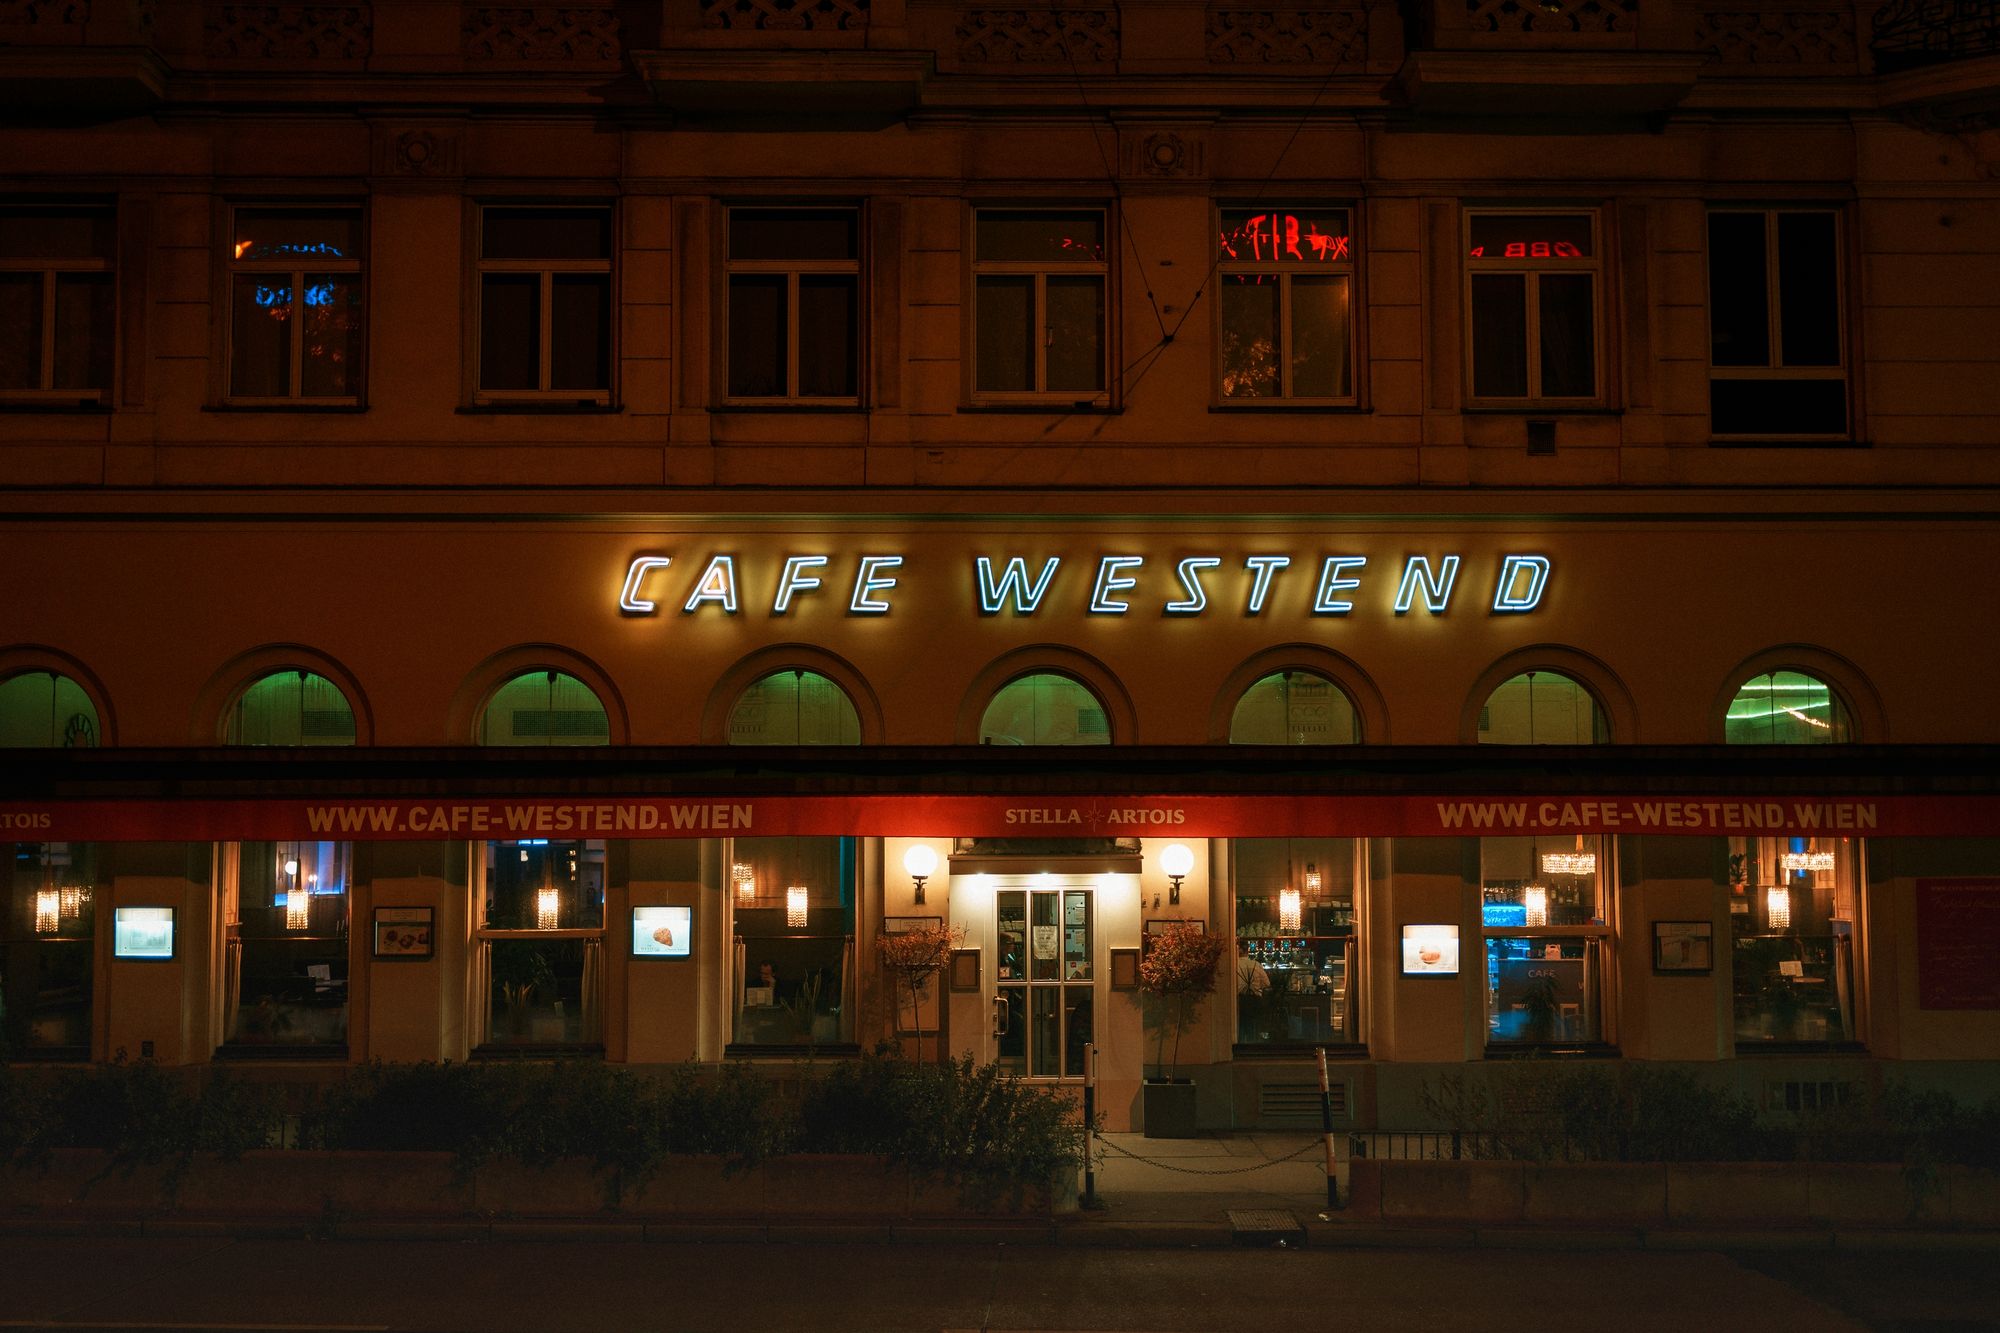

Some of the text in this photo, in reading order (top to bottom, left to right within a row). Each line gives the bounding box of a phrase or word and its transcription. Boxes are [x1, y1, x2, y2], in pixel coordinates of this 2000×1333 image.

[619, 555, 1551, 613] CAFE WESTEND
[0, 812, 51, 829] TOIS
[306, 804, 754, 832] WWW.CAFE-WESTEND.WIEN
[1005, 809, 1185, 824] STELLA ARTOIS
[1436, 803, 1878, 829] WWW.CAFE-WESTEND.WIEN
